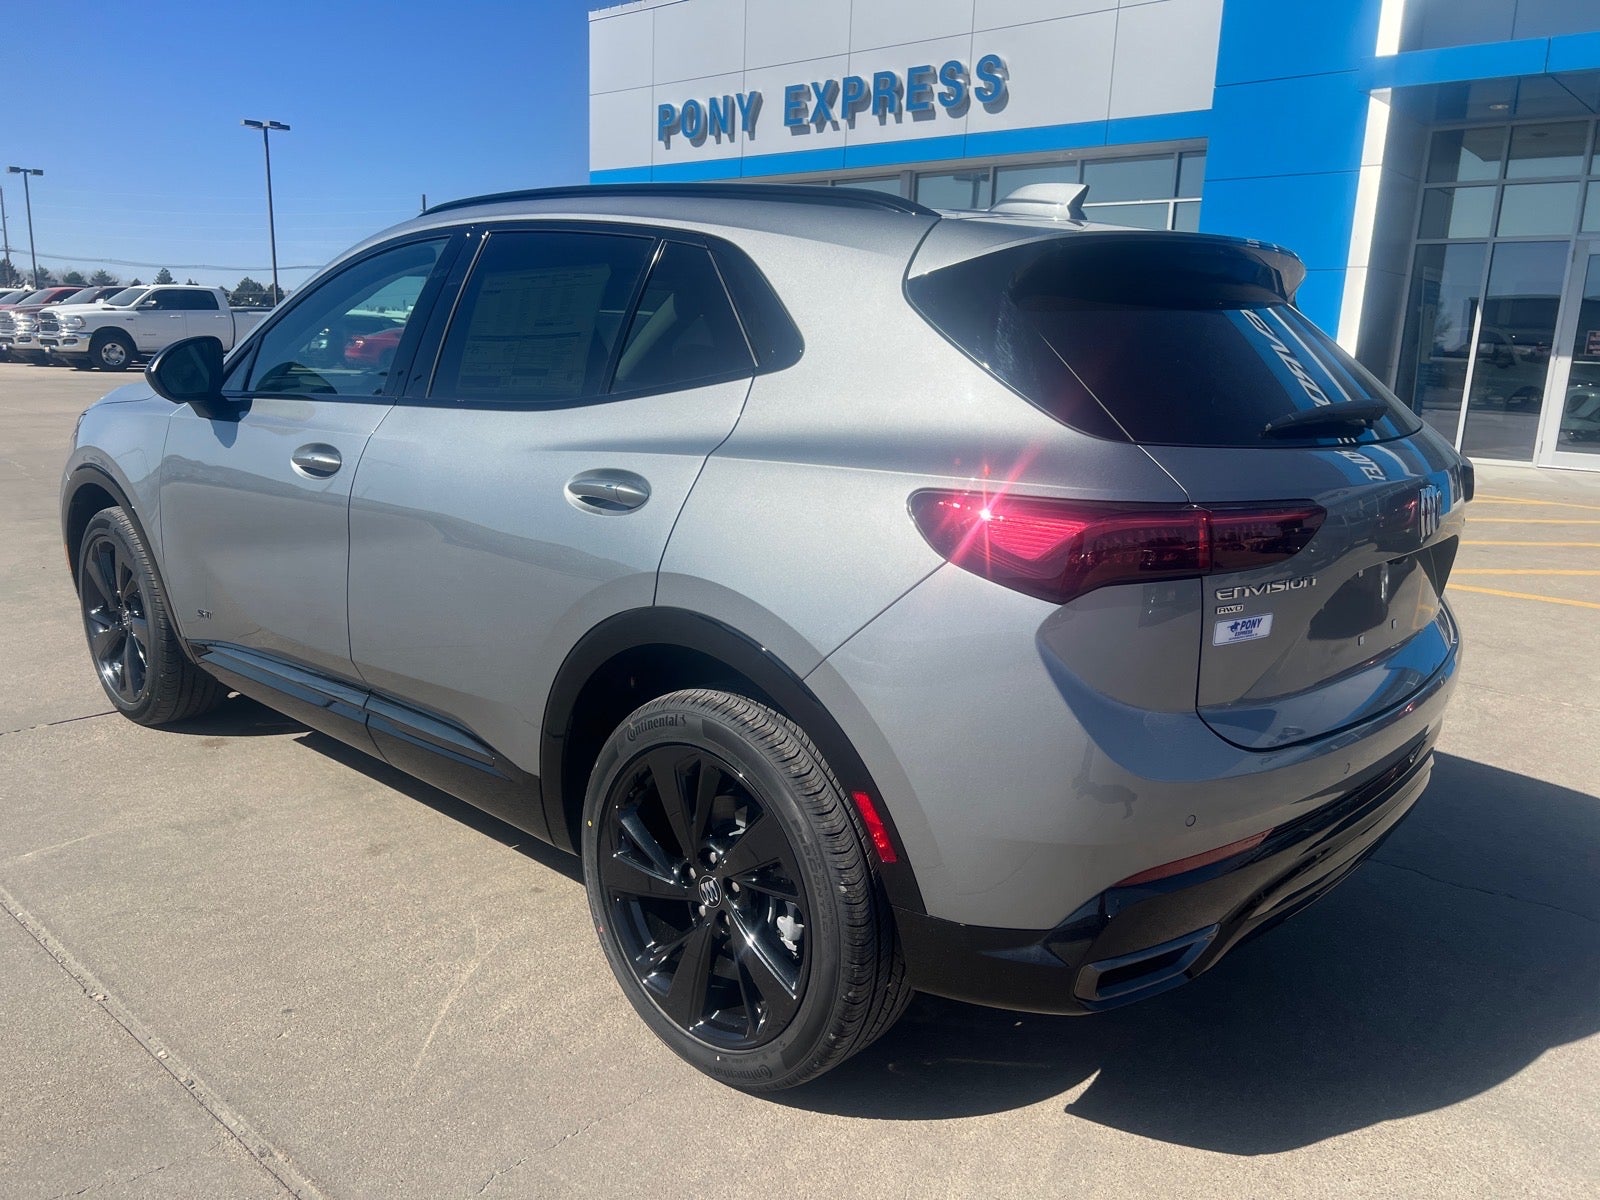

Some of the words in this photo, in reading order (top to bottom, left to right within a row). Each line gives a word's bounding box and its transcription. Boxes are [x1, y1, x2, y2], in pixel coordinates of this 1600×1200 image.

[658, 90, 762, 146] PONY
[784, 54, 1009, 132] EXPRESS
[1215, 576, 1317, 600] ENVISION
[1218, 605, 1243, 614] AWD
[1239, 618, 1263, 631] PONY
[627, 714, 679, 742] Continental
